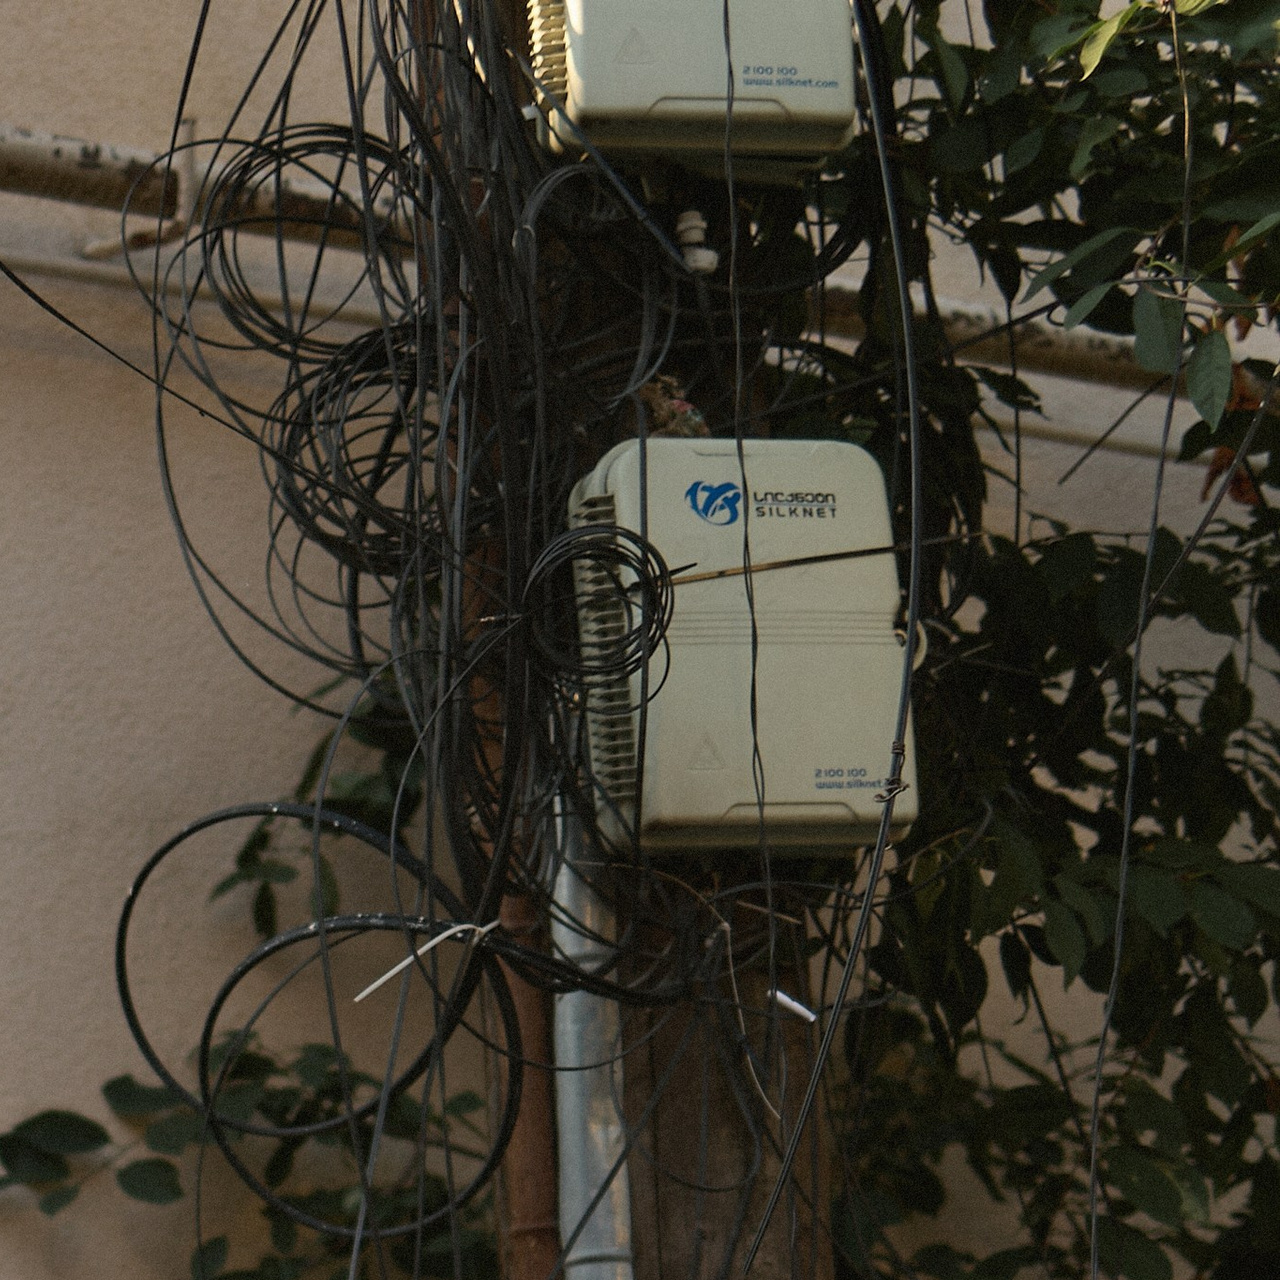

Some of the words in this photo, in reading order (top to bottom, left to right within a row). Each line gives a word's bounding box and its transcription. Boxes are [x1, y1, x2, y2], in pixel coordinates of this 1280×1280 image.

[742, 66, 751, 75] 2
[753, 66, 773, 75] 100
[777, 66, 798, 75] 100
[755, 506, 837, 519] SILKNET
[815, 768, 823, 777] 2
[825, 768, 844, 777] 100
[847, 768, 867, 777] 100
